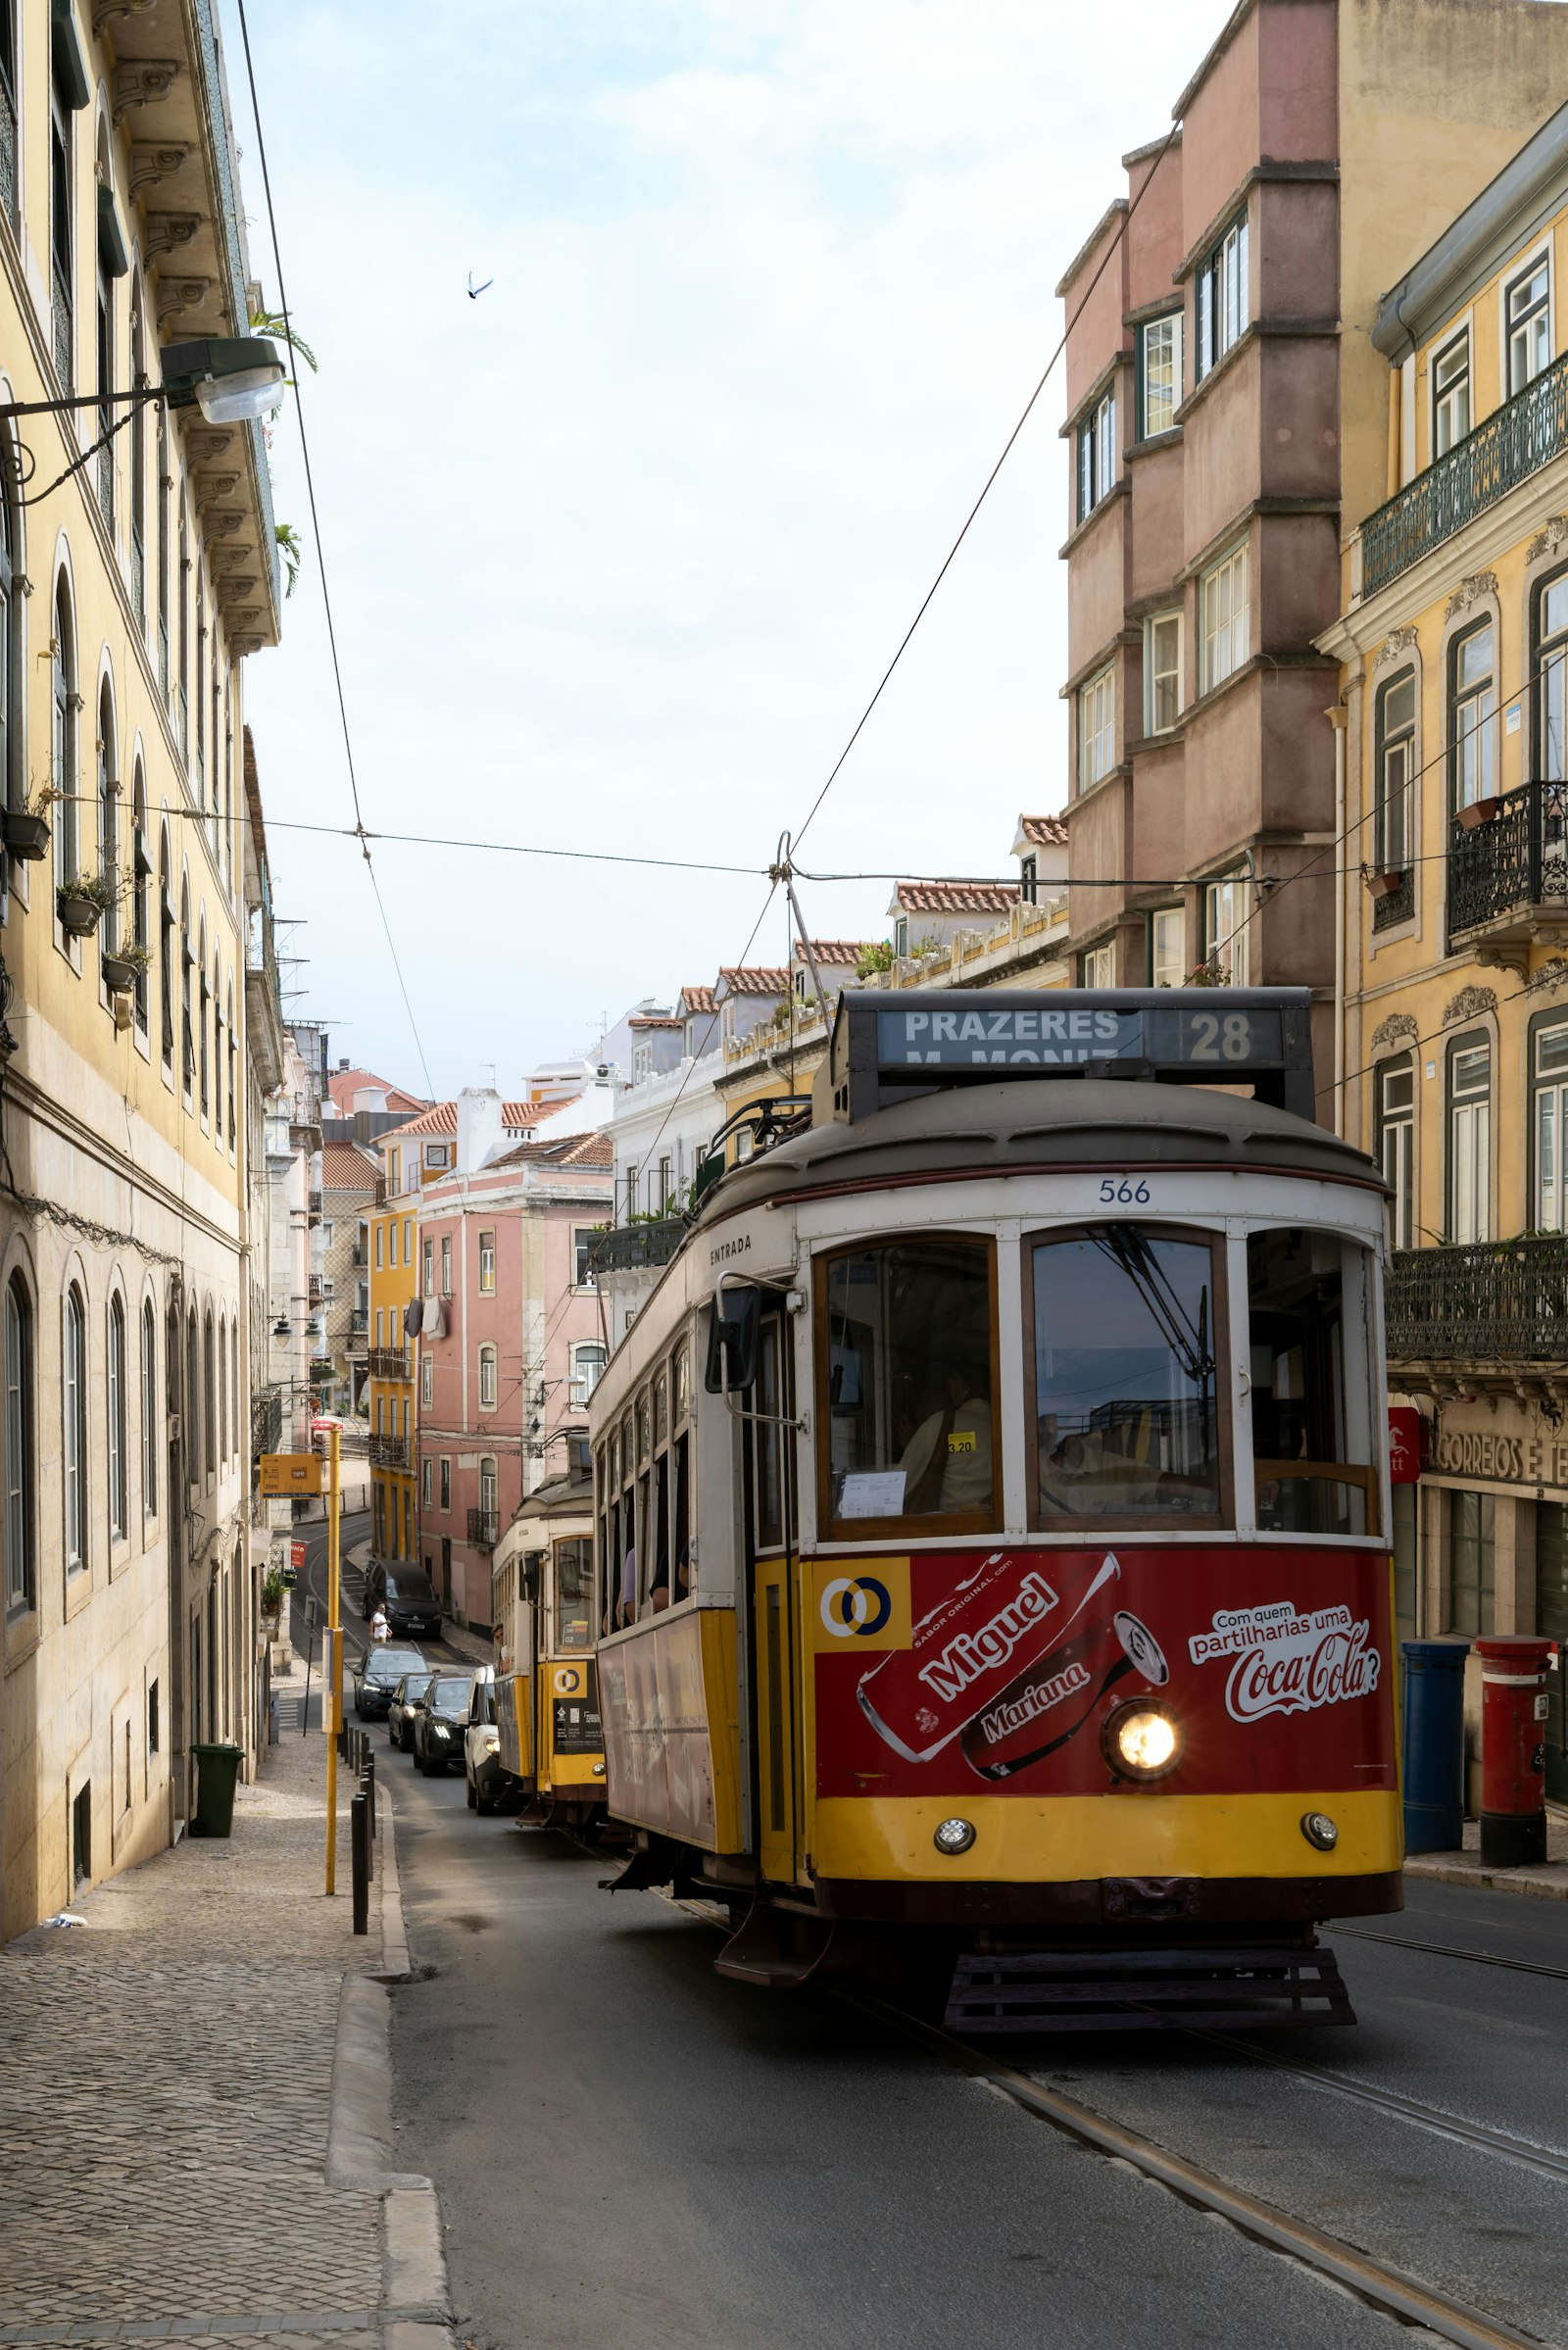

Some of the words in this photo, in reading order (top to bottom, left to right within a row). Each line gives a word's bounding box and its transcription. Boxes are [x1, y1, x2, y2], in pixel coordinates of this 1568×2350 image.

[906, 1010, 1119, 1041] PRAZERES
[1190, 1013, 1250, 1060] 28
[1099, 1179, 1151, 1203] 566
[710, 1235, 752, 1265] ENTRADA
[949, 1442, 972, 1454] 3.20
[1391, 1457, 1404, 1471] tt
[1439, 1434, 1519, 1478] CORREIOS
[1526, 1439, 1538, 1481] E
[913, 1618, 948, 1649] SABOR
[948, 1577, 995, 1618] ORIGINAL
[1194, 1619, 1310, 1659] partilharias
[1315, 1610, 1349, 1631] uma
[1217, 1613, 1250, 1628] Com
[1255, 1606, 1293, 1622] quem
[919, 1573, 1058, 1702] Miguel
[982, 1662, 1090, 1744] Mariana
